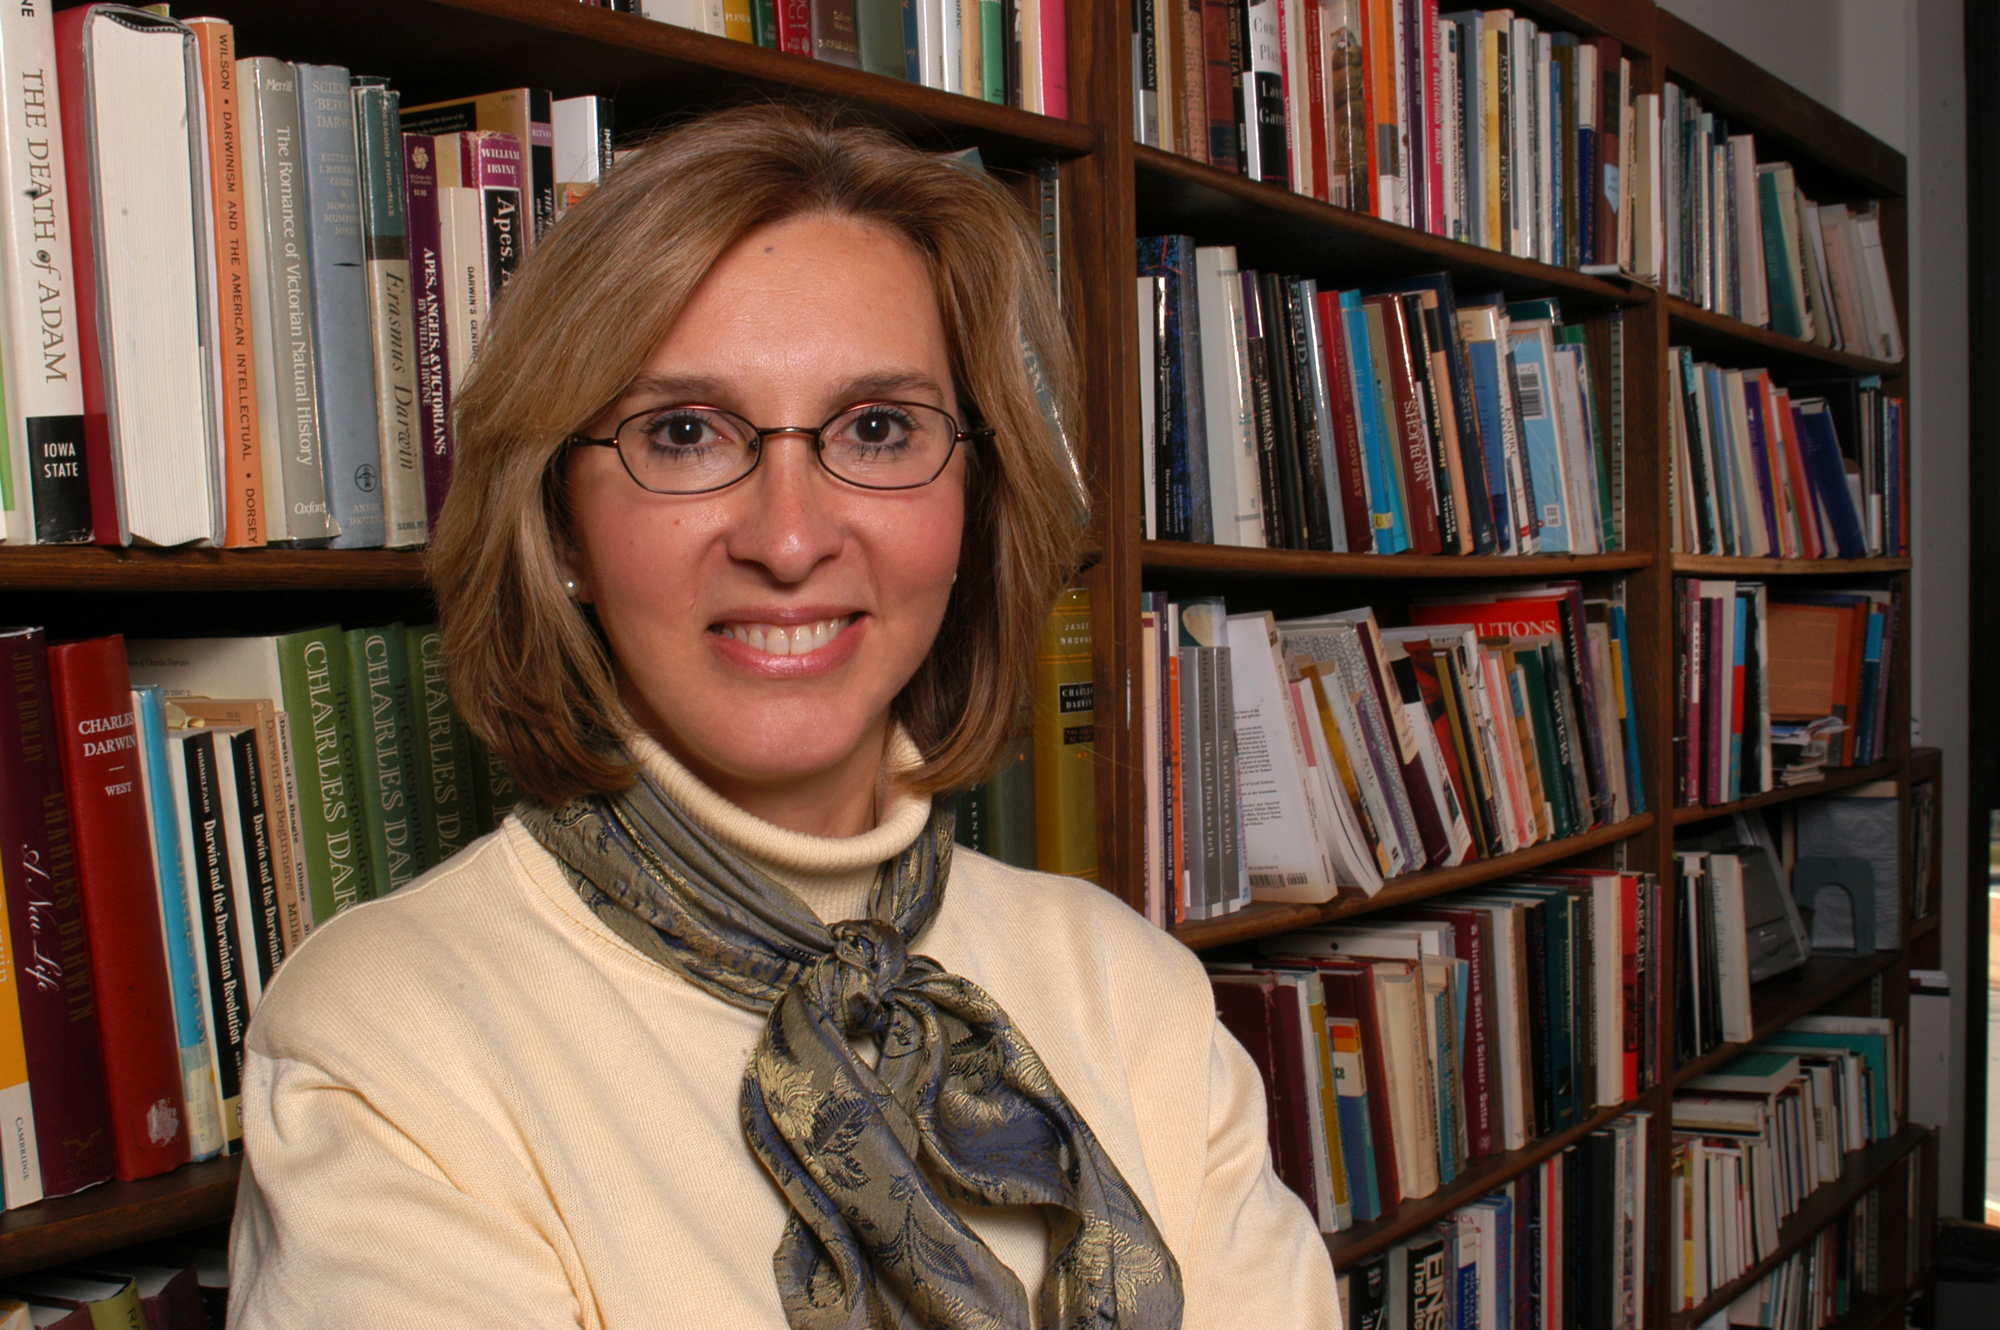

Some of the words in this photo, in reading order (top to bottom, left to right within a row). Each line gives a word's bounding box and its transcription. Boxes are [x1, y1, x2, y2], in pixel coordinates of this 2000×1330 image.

[1146, 16, 1153, 32] OF
[1431, 5, 1440, 55] EVOLUTION
[219, 34, 230, 90] WILSON
[266, 78, 292, 92] Merrill
[1147, 38, 1155, 87] RACISM
[1433, 57, 1441, 69] OF
[1500, 54, 1509, 95] POX
[22, 69, 46, 128] THE
[1434, 71, 1442, 125] INFECTIOUS
[222, 112, 235, 192] DARWINISM
[277, 126, 290, 157] The
[481, 148, 520, 160] WILLIAM
[532, 129, 551, 138] RITVO
[1435, 127, 1443, 166] DISEASE
[28, 138, 56, 242] DEATH
[487, 163, 517, 176] IRVINE
[1500, 154, 1508, 202] FENN
[227, 200, 238, 231] AND
[279, 161, 296, 239] Romance
[544, 188, 552, 213] THE
[229, 238, 240, 266] THE
[286, 243, 300, 260] of
[493, 196, 515, 262] Apes,
[30, 250, 61, 281] of
[424, 247, 438, 290] APES,
[232, 273, 244, 346] AMERICAN
[285, 260, 304, 338] Victorian
[418, 298, 427, 312] BY
[467, 265, 476, 316] DARWIN'S
[38, 281, 68, 384] ADAM
[385, 271, 405, 373] Erasmus
[419, 315, 431, 367] WILLIAM
[426, 290, 441, 352] ANGELS,
[1290, 281, 1308, 366] FREUD
[291, 341, 308, 402] Natural
[429, 352, 441, 365] &
[1422, 332, 1432, 367] THINK
[237, 353, 252, 461] INTELLECTUAL
[421, 370, 432, 406] IRVINE
[430, 364, 448, 456] VICTORIANS
[1427, 373, 1442, 435] "NATIVES"
[297, 407, 313, 466] History
[394, 384, 415, 470] Darwin
[1262, 408, 1276, 452] BRAIN
[1337, 337, 1351, 402] VOYAGES
[1345, 413, 1364, 499] DISCOVERY
[1403, 400, 1422, 457] BLIGH'S
[1504, 405, 1517, 458] EMPIRE
[44, 442, 76, 458] IOWA
[44, 462, 79, 478] STATE
[1413, 458, 1427, 483] MR
[1438, 441, 1447, 468] HOW
[1518, 420, 1528, 466] SCIENCE
[1525, 482, 1537, 532] CONTEXT
[245, 488, 258, 544] DORSEY
[294, 502, 326, 516] Oxford
[1426, 504, 1434, 532] DENING
[1446, 495, 1454, 544] MARSHALL
[1449, 495, 1457, 532] SAHLINS
[1060, 636, 1092, 645] BROWNE
[1064, 622, 1090, 633] JANET
[12, 652, 35, 694] JOHN
[78, 711, 136, 736] CHARLES
[336, 684, 349, 730] The
[365, 634, 404, 812] CHARLES
[420, 633, 458, 805] CHARLES
[1065, 699, 1092, 710] DARWIN
[1277, 663, 1289, 702] Ecology
[1290, 719, 1302, 755] Empire
[1552, 689, 1570, 766] OPTICKS
[17, 701, 44, 763] BOWLBY
[83, 734, 137, 758] DARWIN
[266, 718, 280, 780] Darwin
[304, 641, 348, 824] CHARLES
[1347, 705, 1364, 752] White
[1362, 756, 1376, 790] Nile
[104, 781, 133, 797] WEST
[197, 747, 211, 814] HIMMELFARB
[273, 783, 283, 807] for
[280, 719, 289, 763] Darwin
[285, 766, 292, 778] of
[289, 803, 299, 844] Beagle
[204, 818, 221, 861] Darwin
[253, 812, 270, 860] Darwin
[1207, 815, 1213, 827] on
[1225, 812, 1231, 825] on
[43, 791, 75, 911] CHARLES
[259, 860, 274, 885] and
[276, 810, 293, 892] Beginners
[209, 862, 224, 892] and
[262, 885, 275, 906] the
[26, 878, 57, 938] New
[212, 893, 226, 913] the
[1636, 883, 1646, 931] DARK
[25, 940, 63, 993] Life
[214, 911, 232, 980] Darwinian
[1472, 937, 1481, 992] Victorian
[1636, 938, 1645, 973] SUN
[58, 919, 94, 1023] DARWIN
[222, 979, 242, 1046] Revolution
[1411, 1000, 1419, 1020] The
[1474, 993, 1484, 1029] World
[1413, 1025, 1422, 1054] Edge
[1477, 1044, 1486, 1084] Science
[1418, 1075, 1428, 1142] Objectivity
[1444, 1078, 1452, 1110] EARLY
[1480, 1092, 1489, 1130] Sutton
[15, 1116, 30, 1182] CAMBRIDGE
[1414, 1262, 1427, 1295] The
[1414, 1300, 1427, 1330] Life
